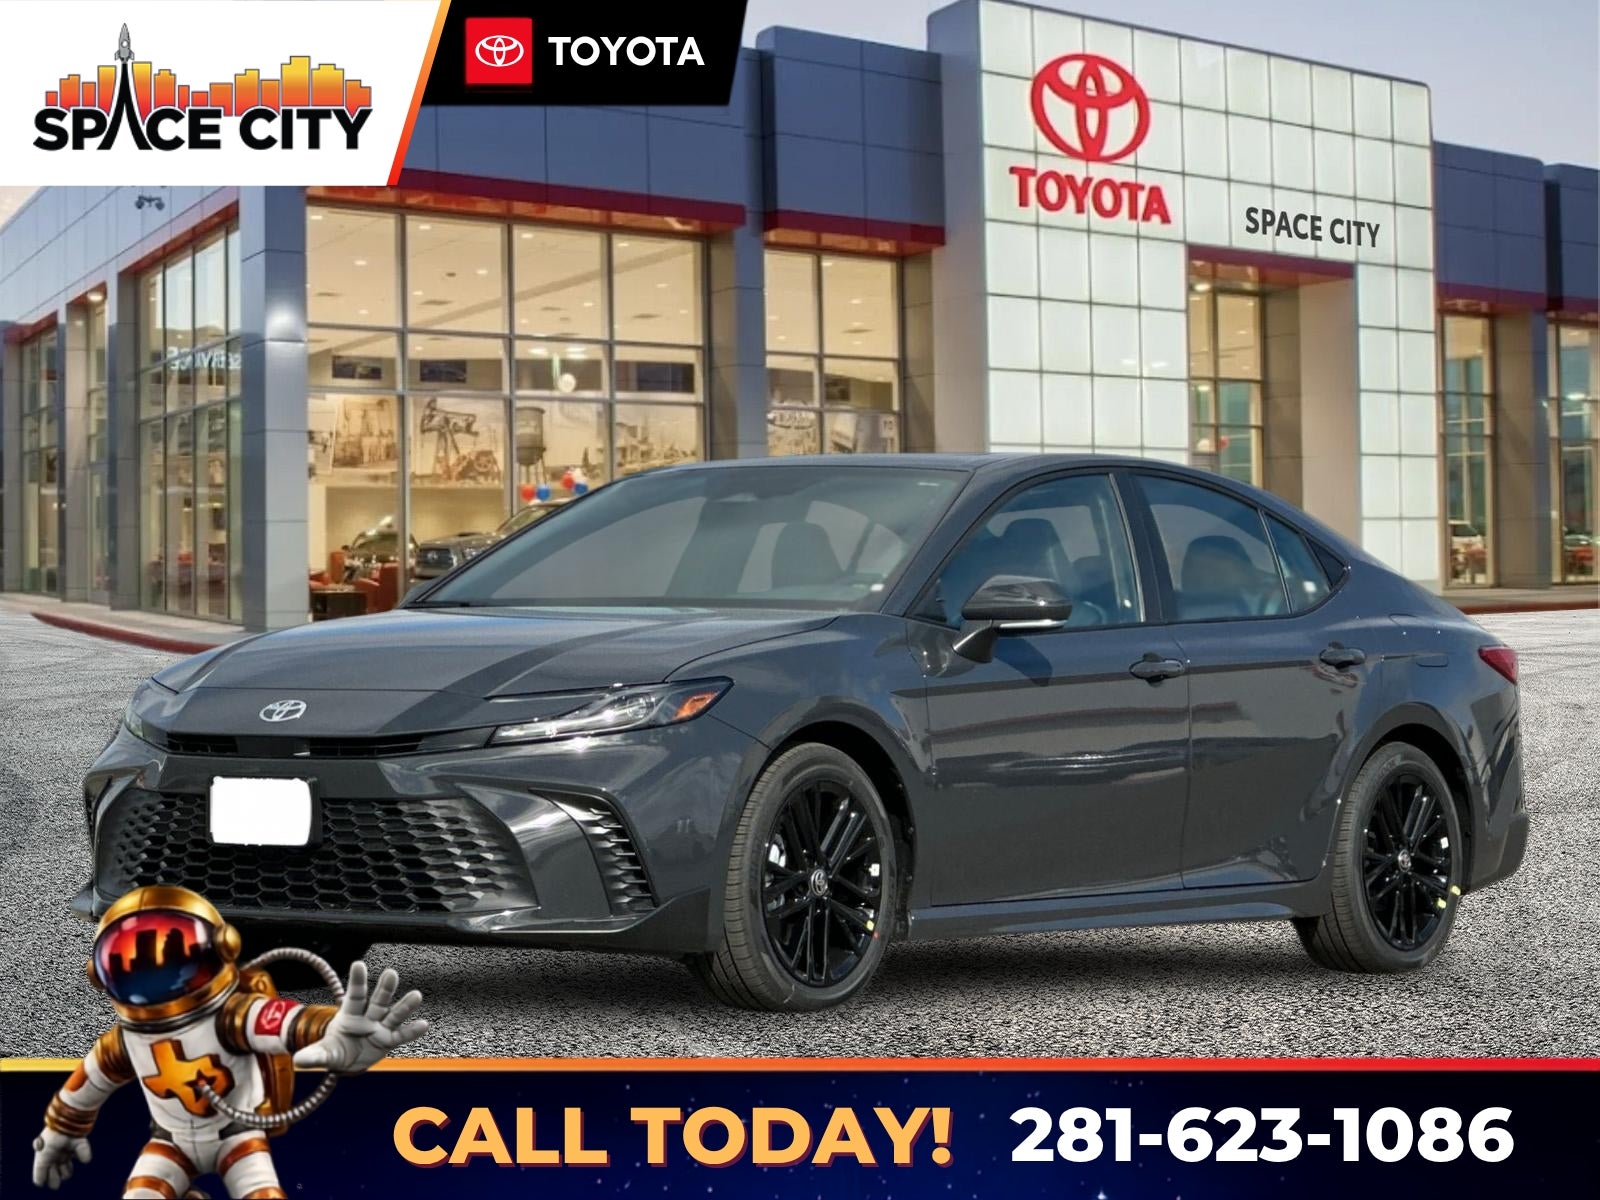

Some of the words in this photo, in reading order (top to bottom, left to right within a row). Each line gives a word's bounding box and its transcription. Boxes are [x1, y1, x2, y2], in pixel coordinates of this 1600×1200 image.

[1009, 166, 1171, 224] TOYOTA
[1245, 206, 1323, 242] SPACE
[1329, 218, 1381, 248] CITY
